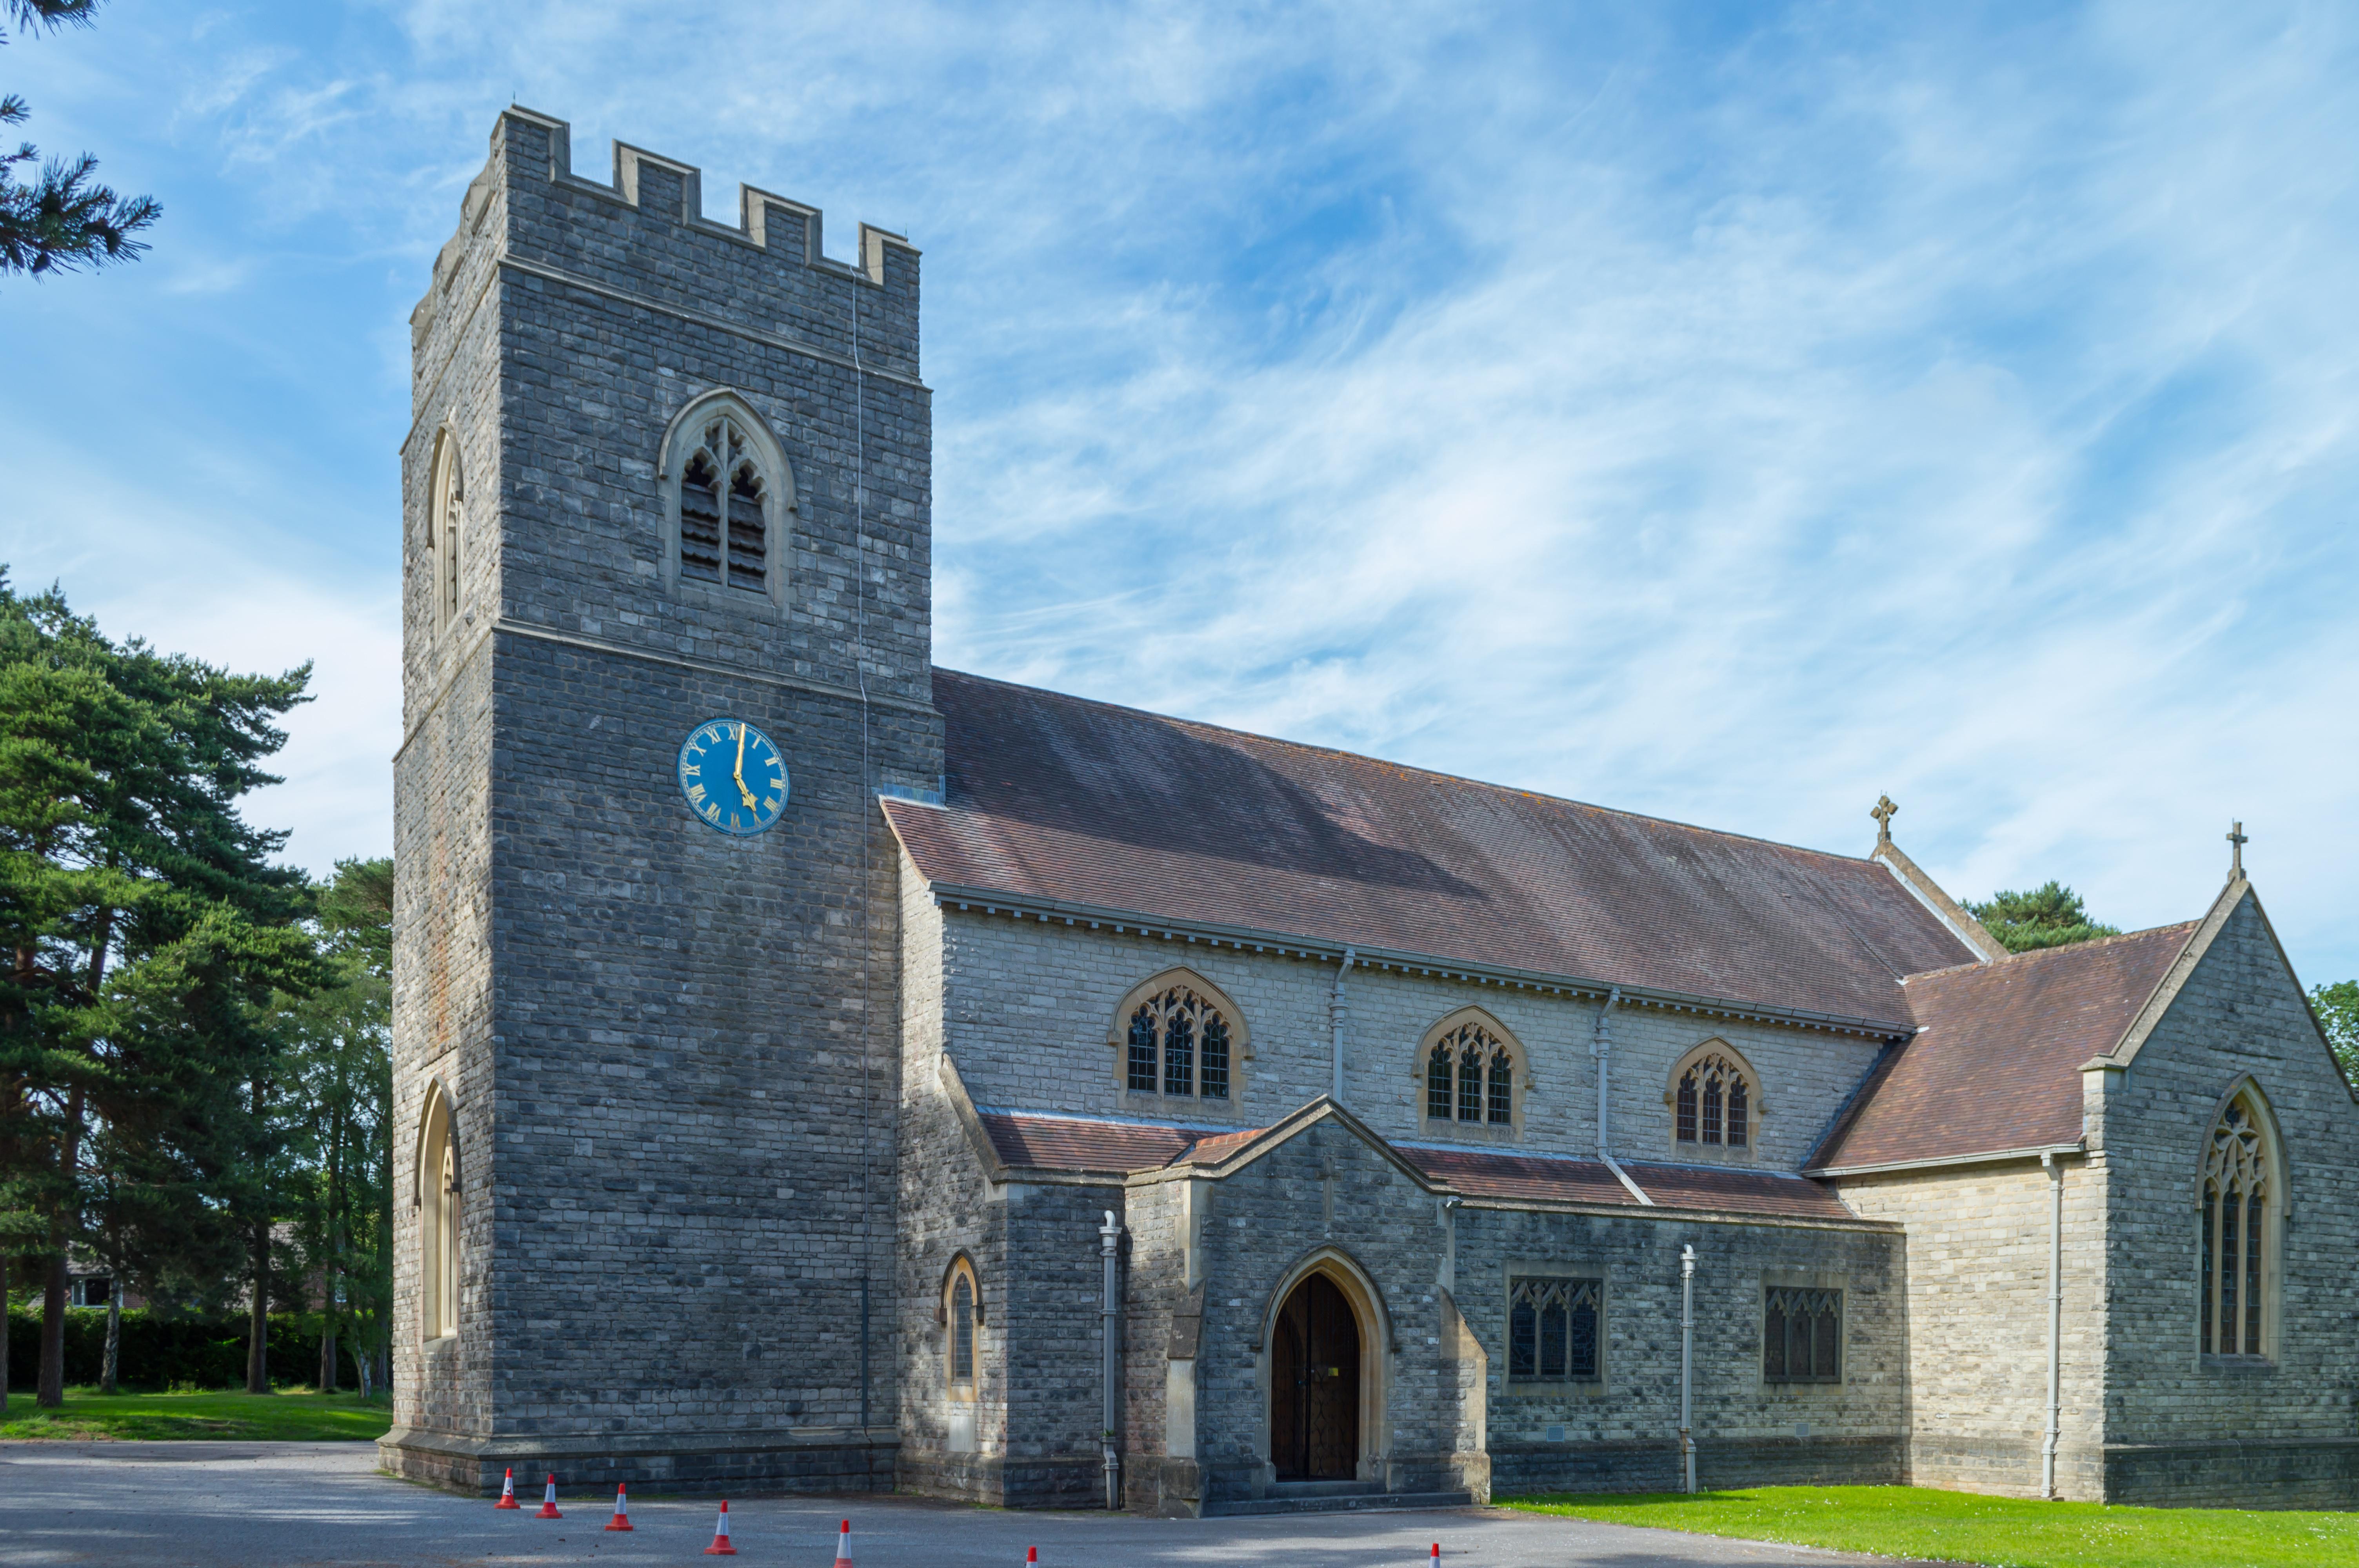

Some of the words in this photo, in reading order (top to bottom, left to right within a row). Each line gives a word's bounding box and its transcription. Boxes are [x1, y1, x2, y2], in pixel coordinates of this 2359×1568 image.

[705, 727, 722, 744] XI
[691, 742, 707, 757] X
[770, 778, 783, 789] III
